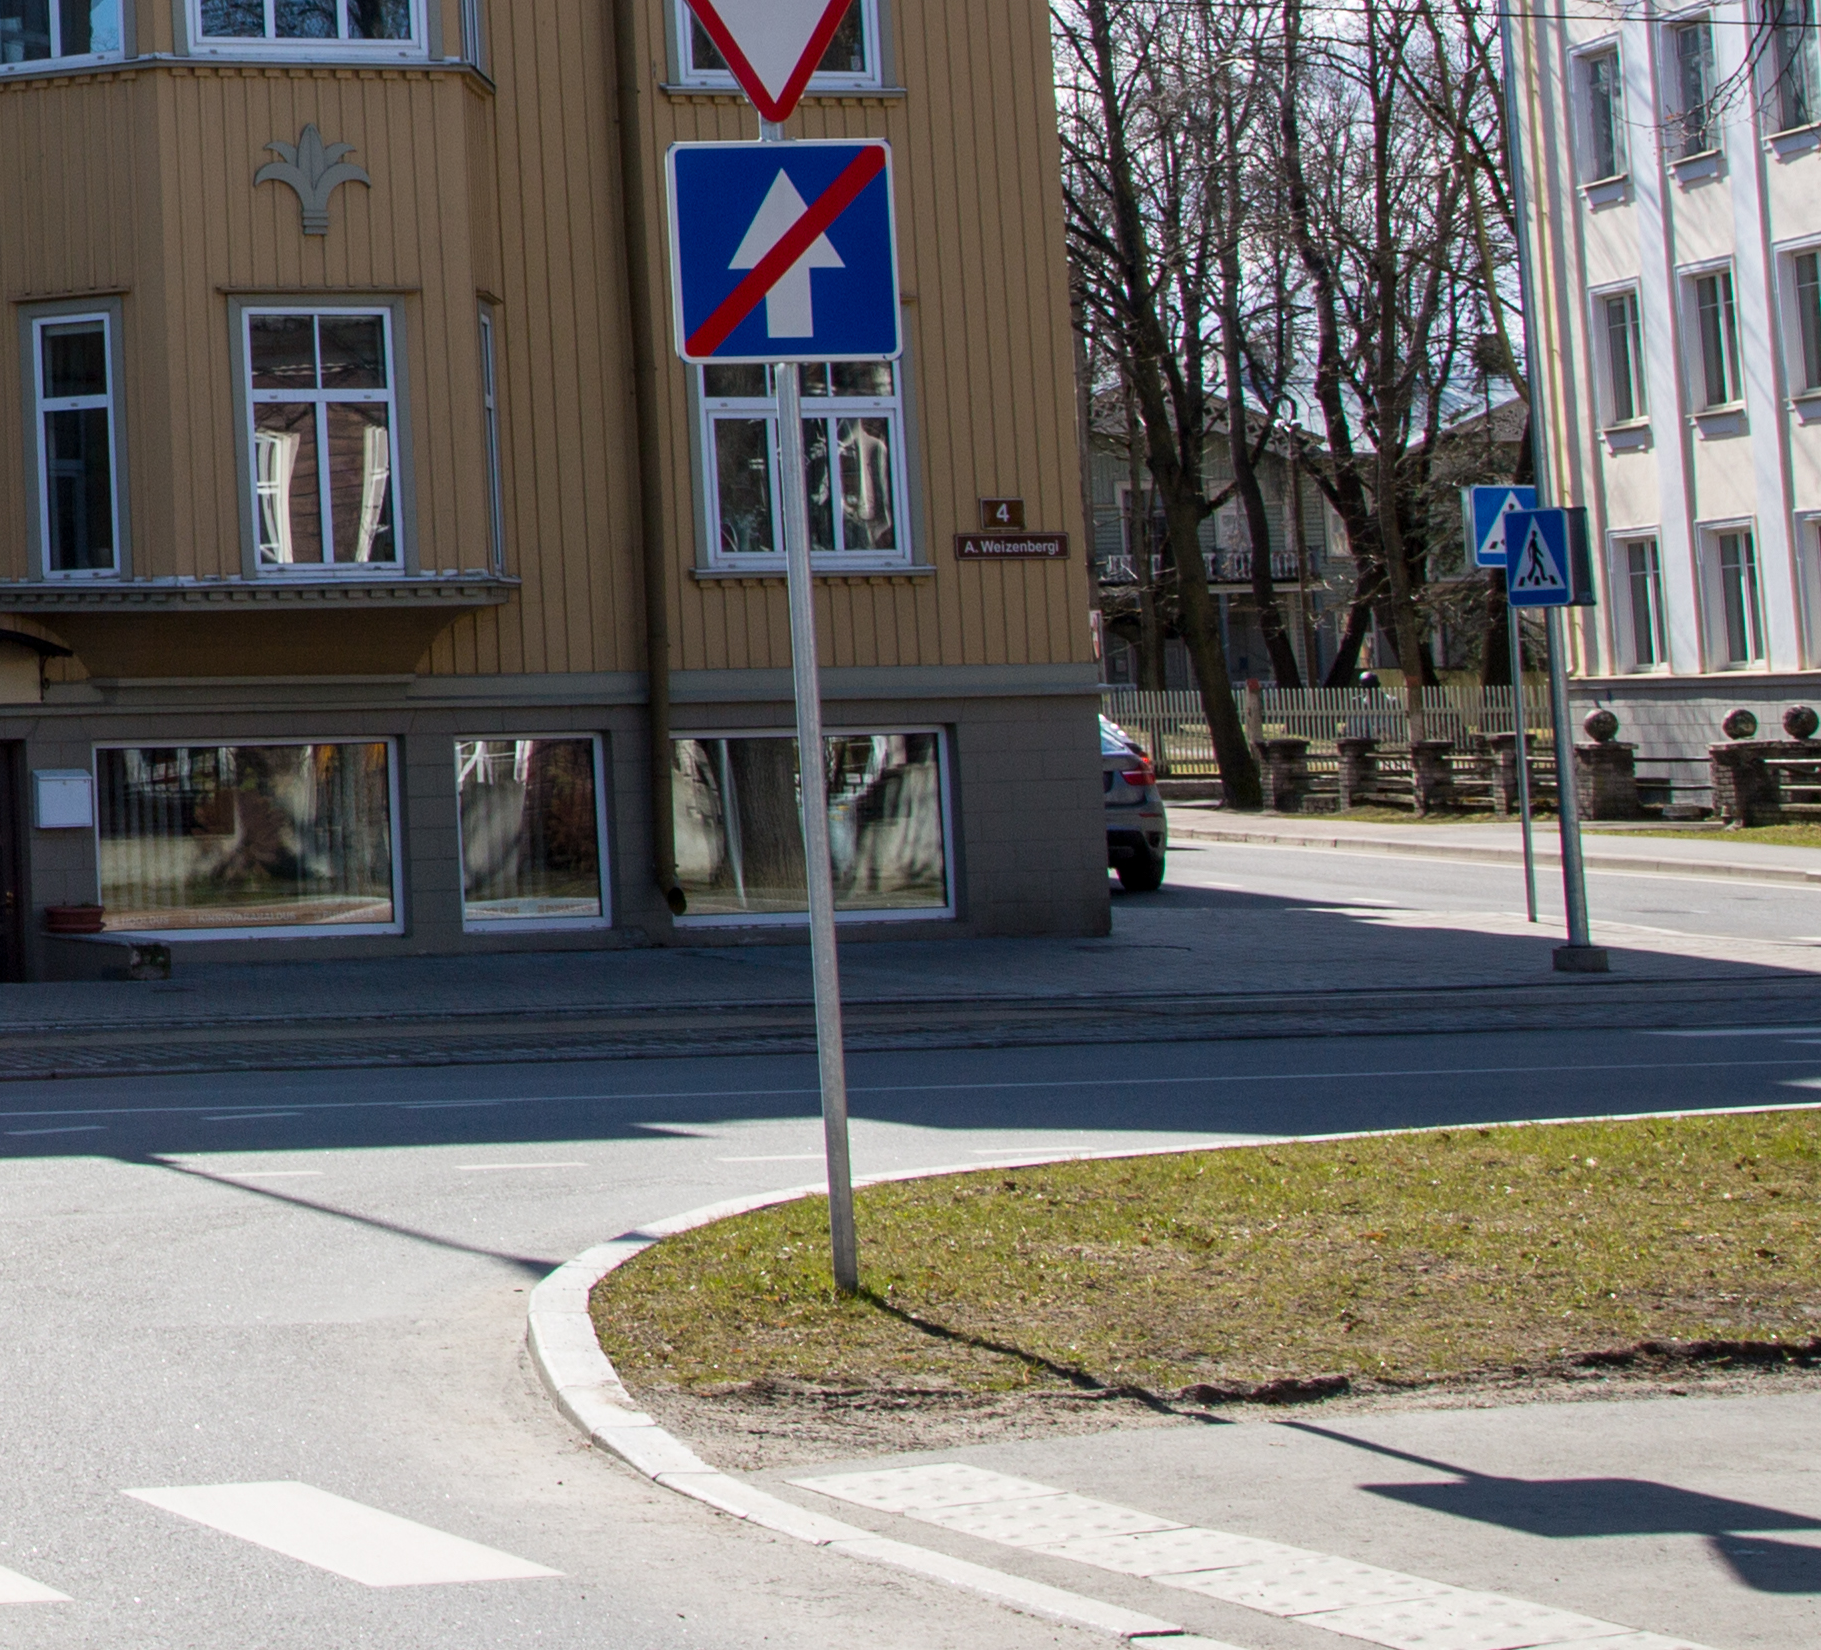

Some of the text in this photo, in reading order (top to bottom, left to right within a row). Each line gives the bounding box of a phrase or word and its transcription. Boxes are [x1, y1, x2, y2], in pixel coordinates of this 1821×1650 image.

[996, 503, 1010, 522] 4
[964, 540, 1059, 555] A. Weizenbergi
